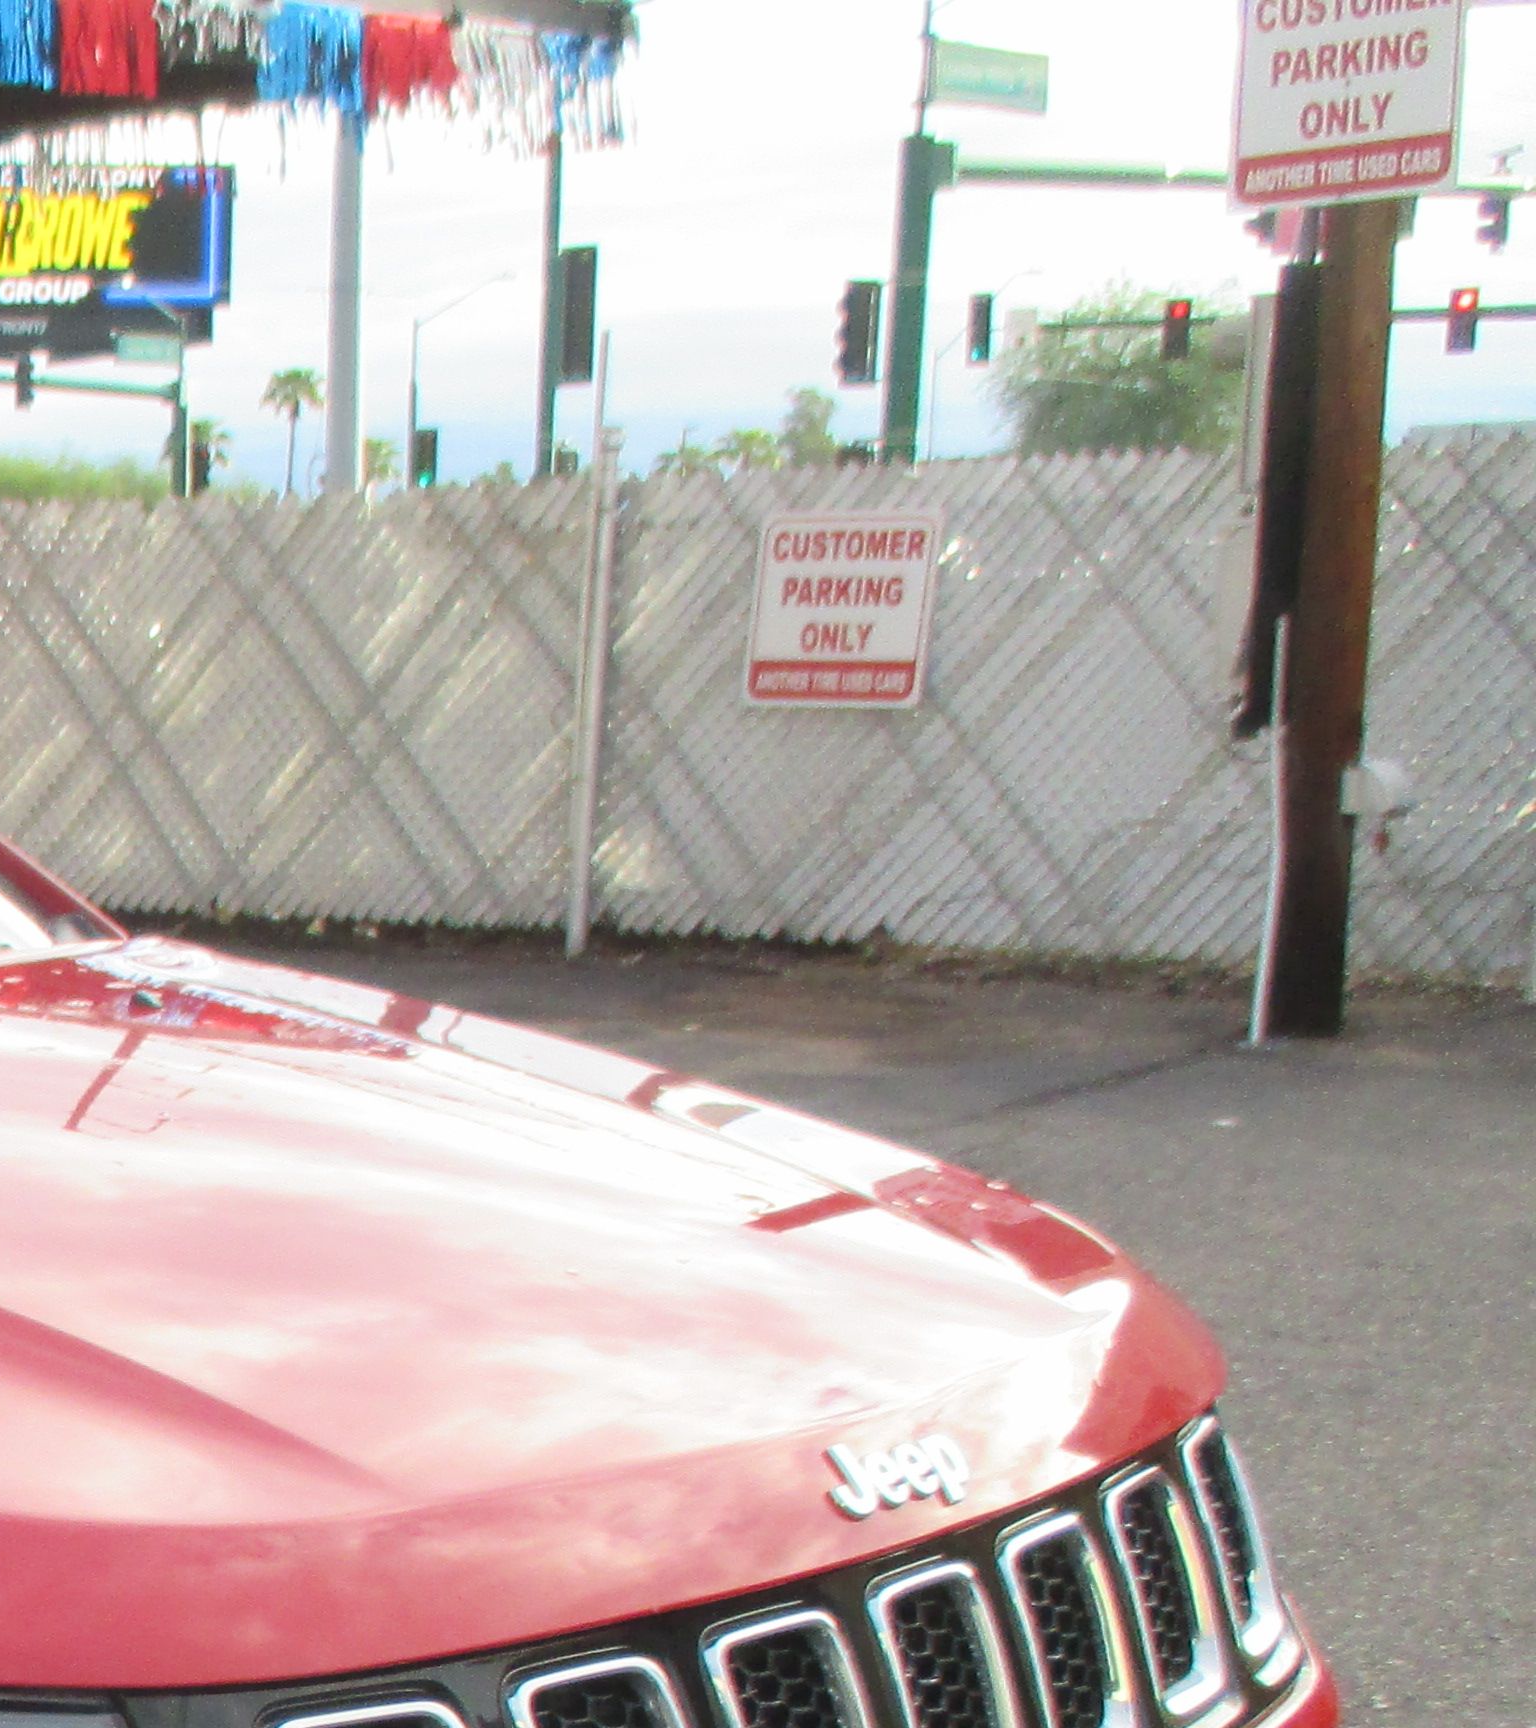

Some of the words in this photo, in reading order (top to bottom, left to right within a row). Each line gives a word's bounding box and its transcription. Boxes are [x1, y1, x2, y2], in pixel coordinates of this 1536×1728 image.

[1255, 0, 1450, 33] CUSTO
[1270, 29, 1427, 87] PARKING
[1298, 92, 1393, 139] ONLY
[773, 530, 926, 562] CUSTOMER
[782, 577, 904, 607] PARKING
[799, 622, 874, 653] ONLY
[826, 1434, 969, 1518] Jeep
